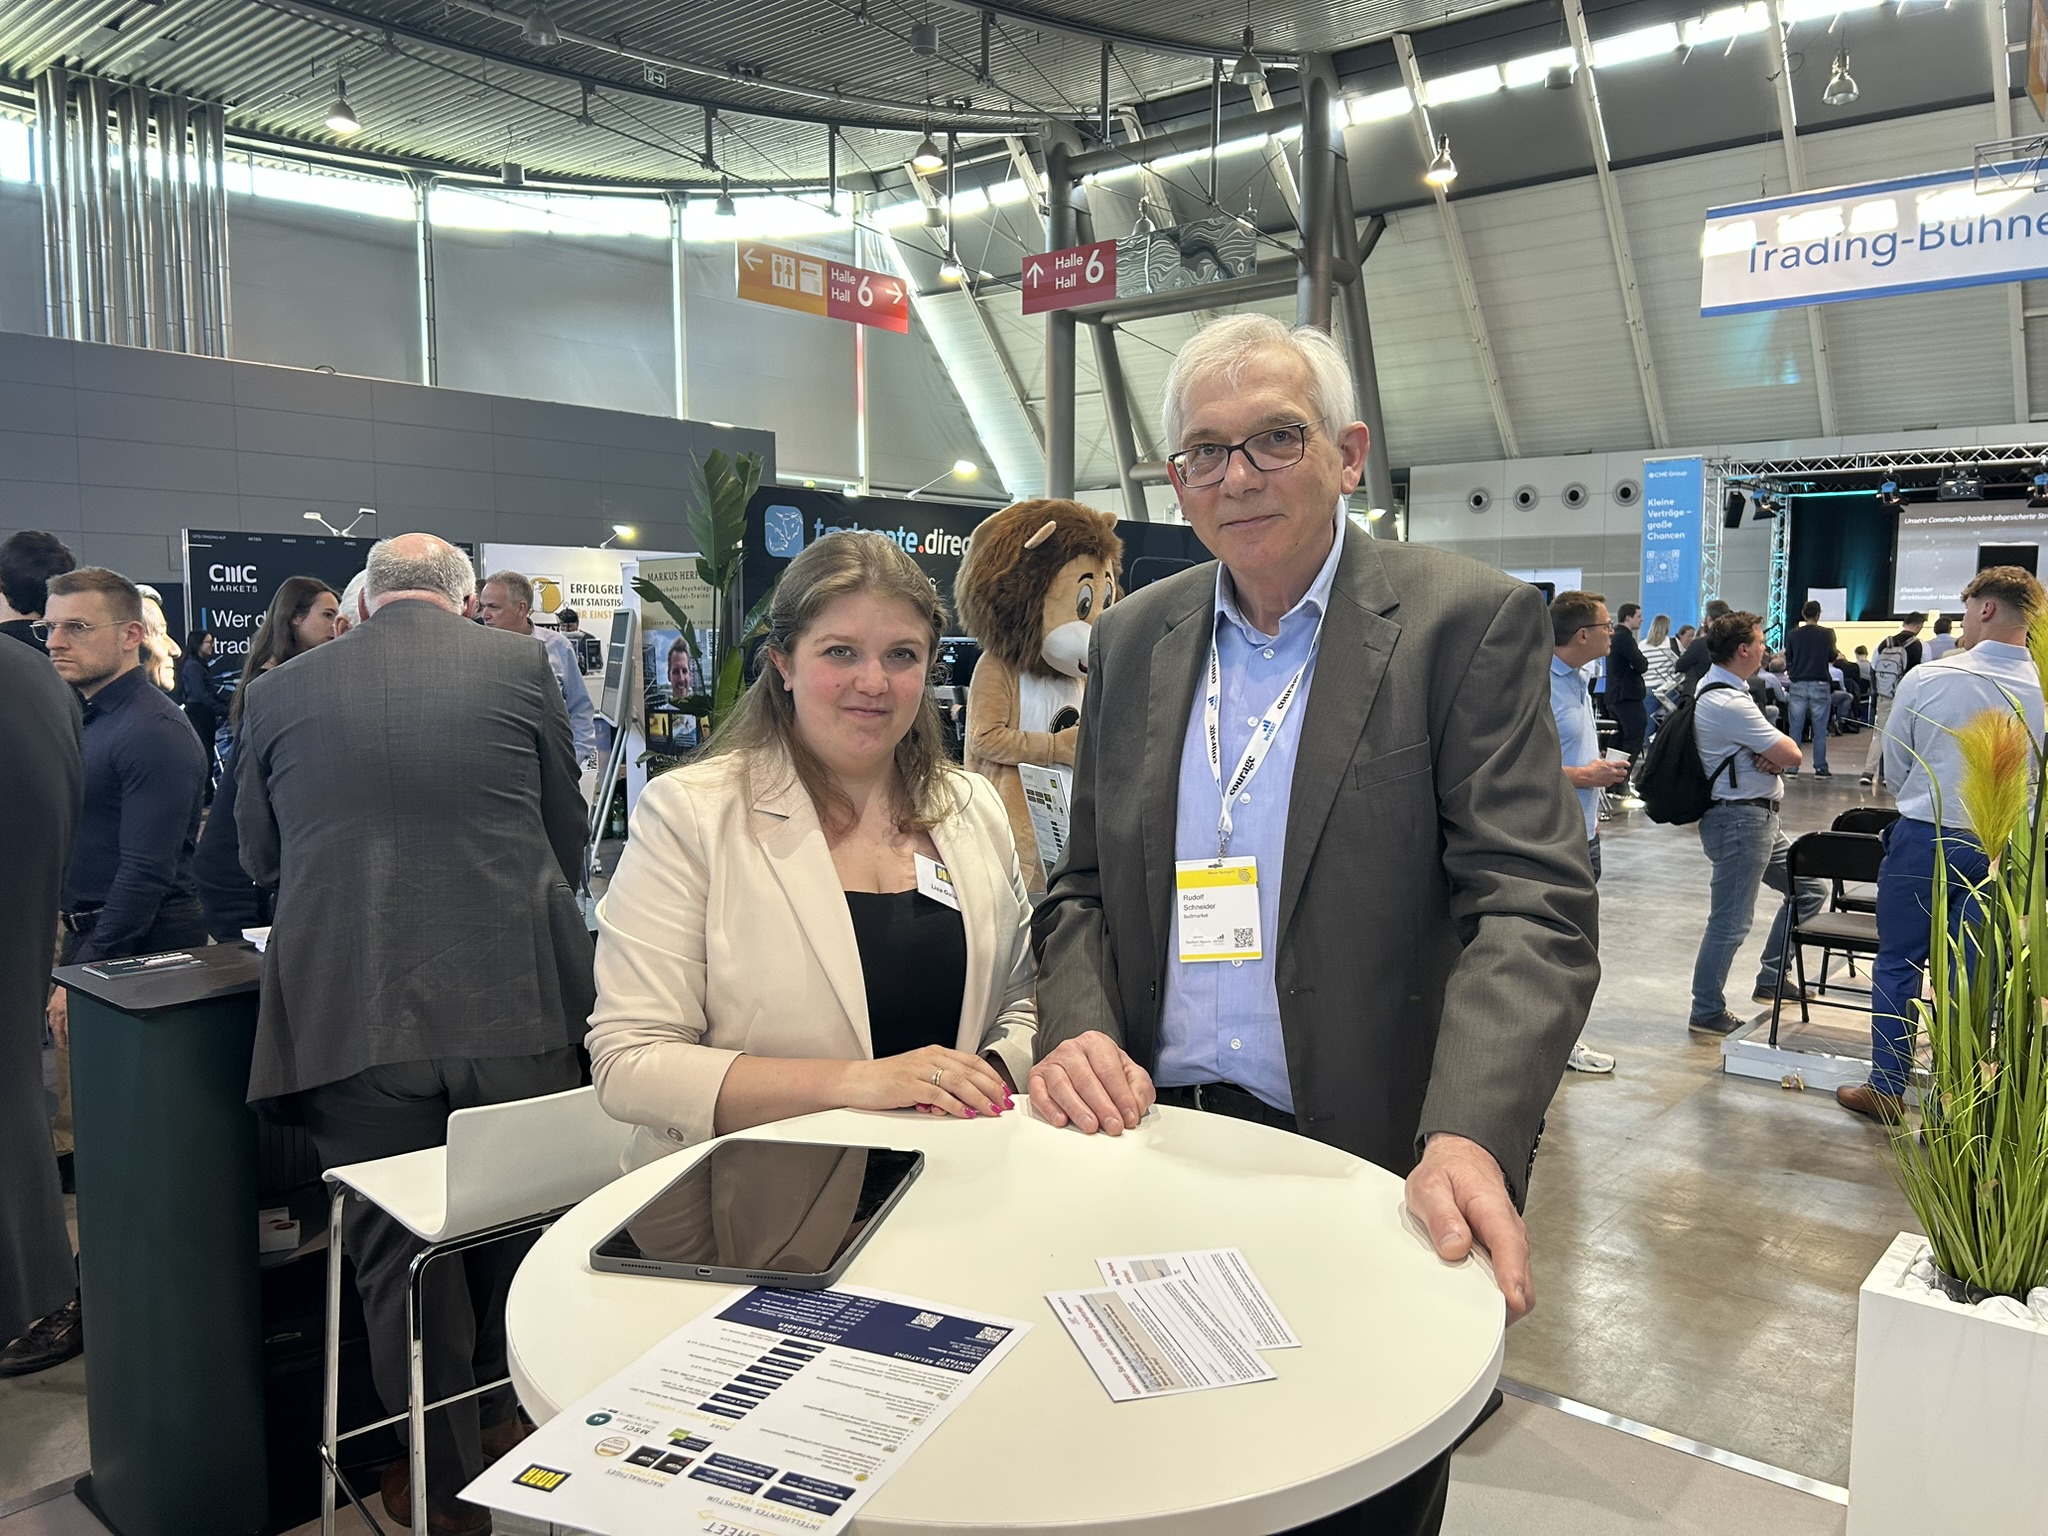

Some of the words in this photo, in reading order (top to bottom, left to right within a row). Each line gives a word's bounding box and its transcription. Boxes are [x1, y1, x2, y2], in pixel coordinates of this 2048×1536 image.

[1055, 252, 1084, 270] Halle
[1085, 249, 1104, 284] 6
[831, 268, 856, 285] Halle
[857, 275, 873, 307] 6
[1055, 273, 1077, 290] Hall
[831, 287, 850, 303] Hall
[1647, 498, 1675, 506] Kleine
[1647, 509, 1685, 519] Verträge
[1928, 516, 1966, 524] Community
[1967, 514, 1993, 522] handelt
[1993, 513, 2037, 522] abgesicherte
[1647, 520, 1673, 531] große
[1647, 531, 1686, 540] Chancen
[208, 563, 258, 583] CMC
[647, 571, 678, 582] MARKUS
[210, 584, 258, 593] MARKETS
[570, 583, 623, 595] ERFOLGREI
[570, 598, 584, 607] MIT
[212, 610, 251, 628] Wer
[589, 610, 612, 619] EINST
[213, 636, 251, 655] trad
[1263, 722, 1278, 741] INVEST
[1209, 723, 1218, 764] courage
[1229, 755, 1256, 796] courage
[931, 883, 943, 893] Lisa
[1183, 903, 1216, 911] Schneider
[775, 1322, 845, 1337] FINANZKALENDER
[806, 1332, 840, 1342] AUSZUG
[891, 1350, 937, 1362] RELATIONS
[937, 1356, 978, 1367] KONTAKT
[933, 1359, 975, 1371] INVESTOR
[621, 1423, 651, 1435] MSCI
[708, 1422, 732, 1431] PORR
[515, 1465, 566, 1491] PORR
[604, 1467, 665, 1489] NACHHALTIGES
[705, 1493, 754, 1512] WACHSTUM
[752, 1506, 820, 1532] INTELLIGENTES
